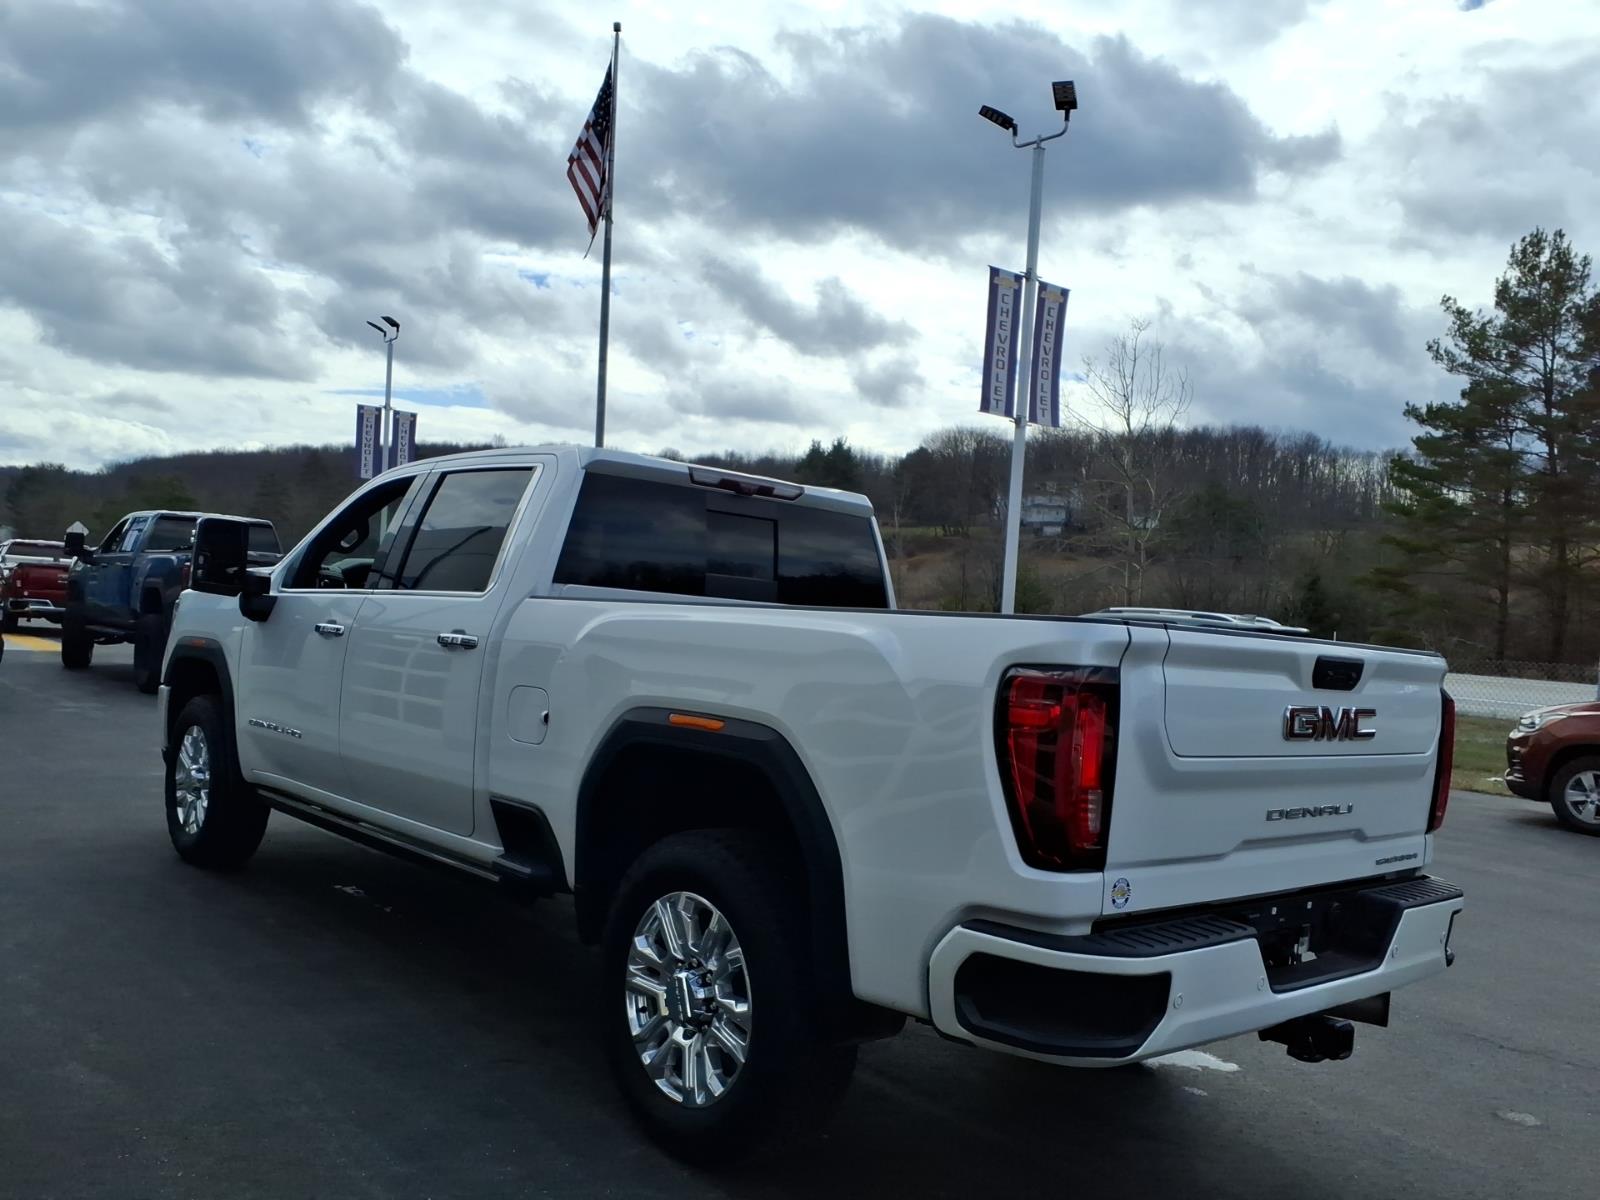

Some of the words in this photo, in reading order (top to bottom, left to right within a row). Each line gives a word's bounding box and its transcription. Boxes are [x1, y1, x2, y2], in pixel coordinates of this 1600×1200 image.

[993, 294, 1009, 409] CHEVROLET
[1039, 307, 1055, 418] CHEVROLET
[1283, 705, 1377, 742] GMC
[1266, 803, 1354, 822] DENALI
